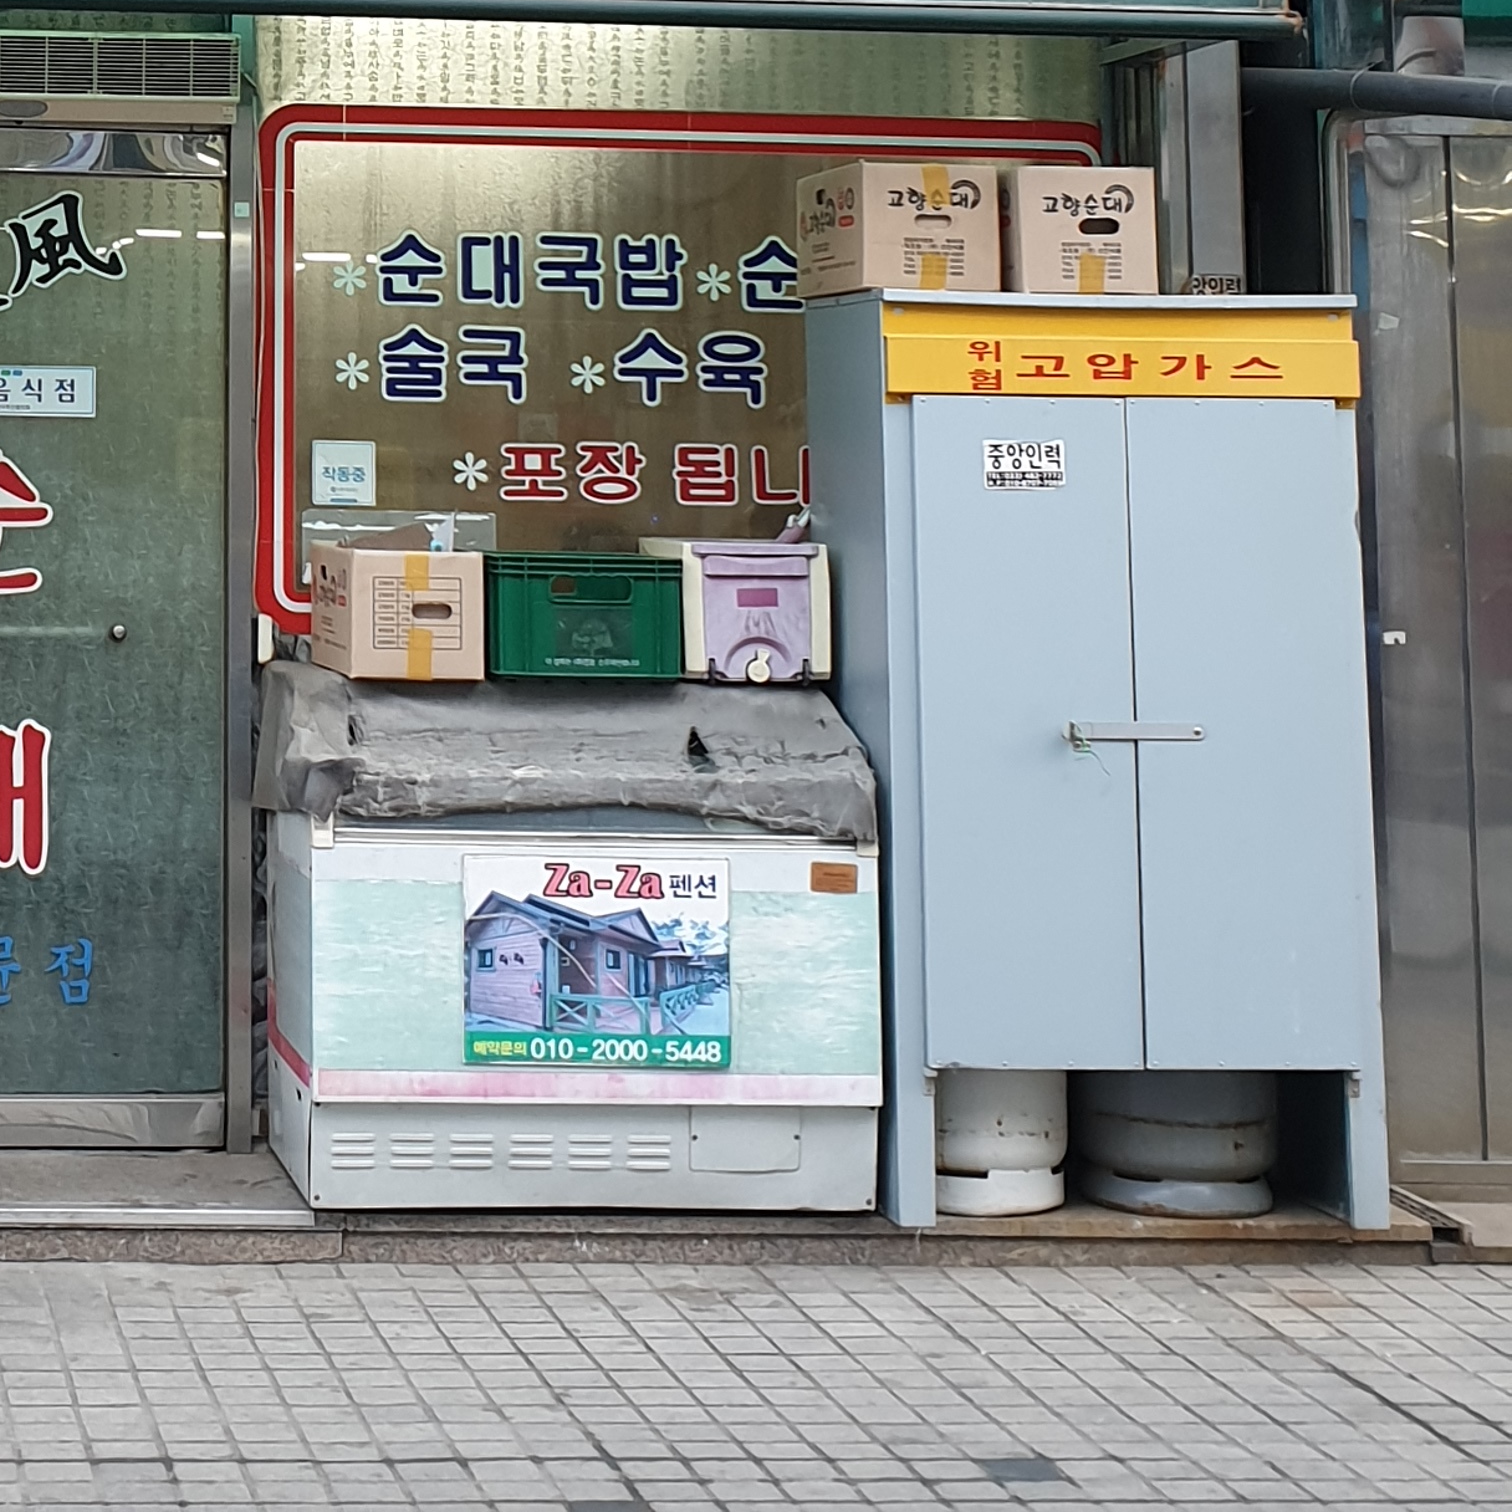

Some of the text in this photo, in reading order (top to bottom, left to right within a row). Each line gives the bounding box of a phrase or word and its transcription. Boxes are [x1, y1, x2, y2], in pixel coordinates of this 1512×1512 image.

[1042, 192, 1123, 218] 고향순대
[376, 229, 688, 311] 순대국밥
[378, 322, 768, 410] 술국 수육
[967, 340, 1284, 391] 위험 고압가스
[498, 440, 647, 505] 포장
[987, 443, 1061, 470] 중앙인력
[542, 862, 717, 900] Za-Za 펜션
